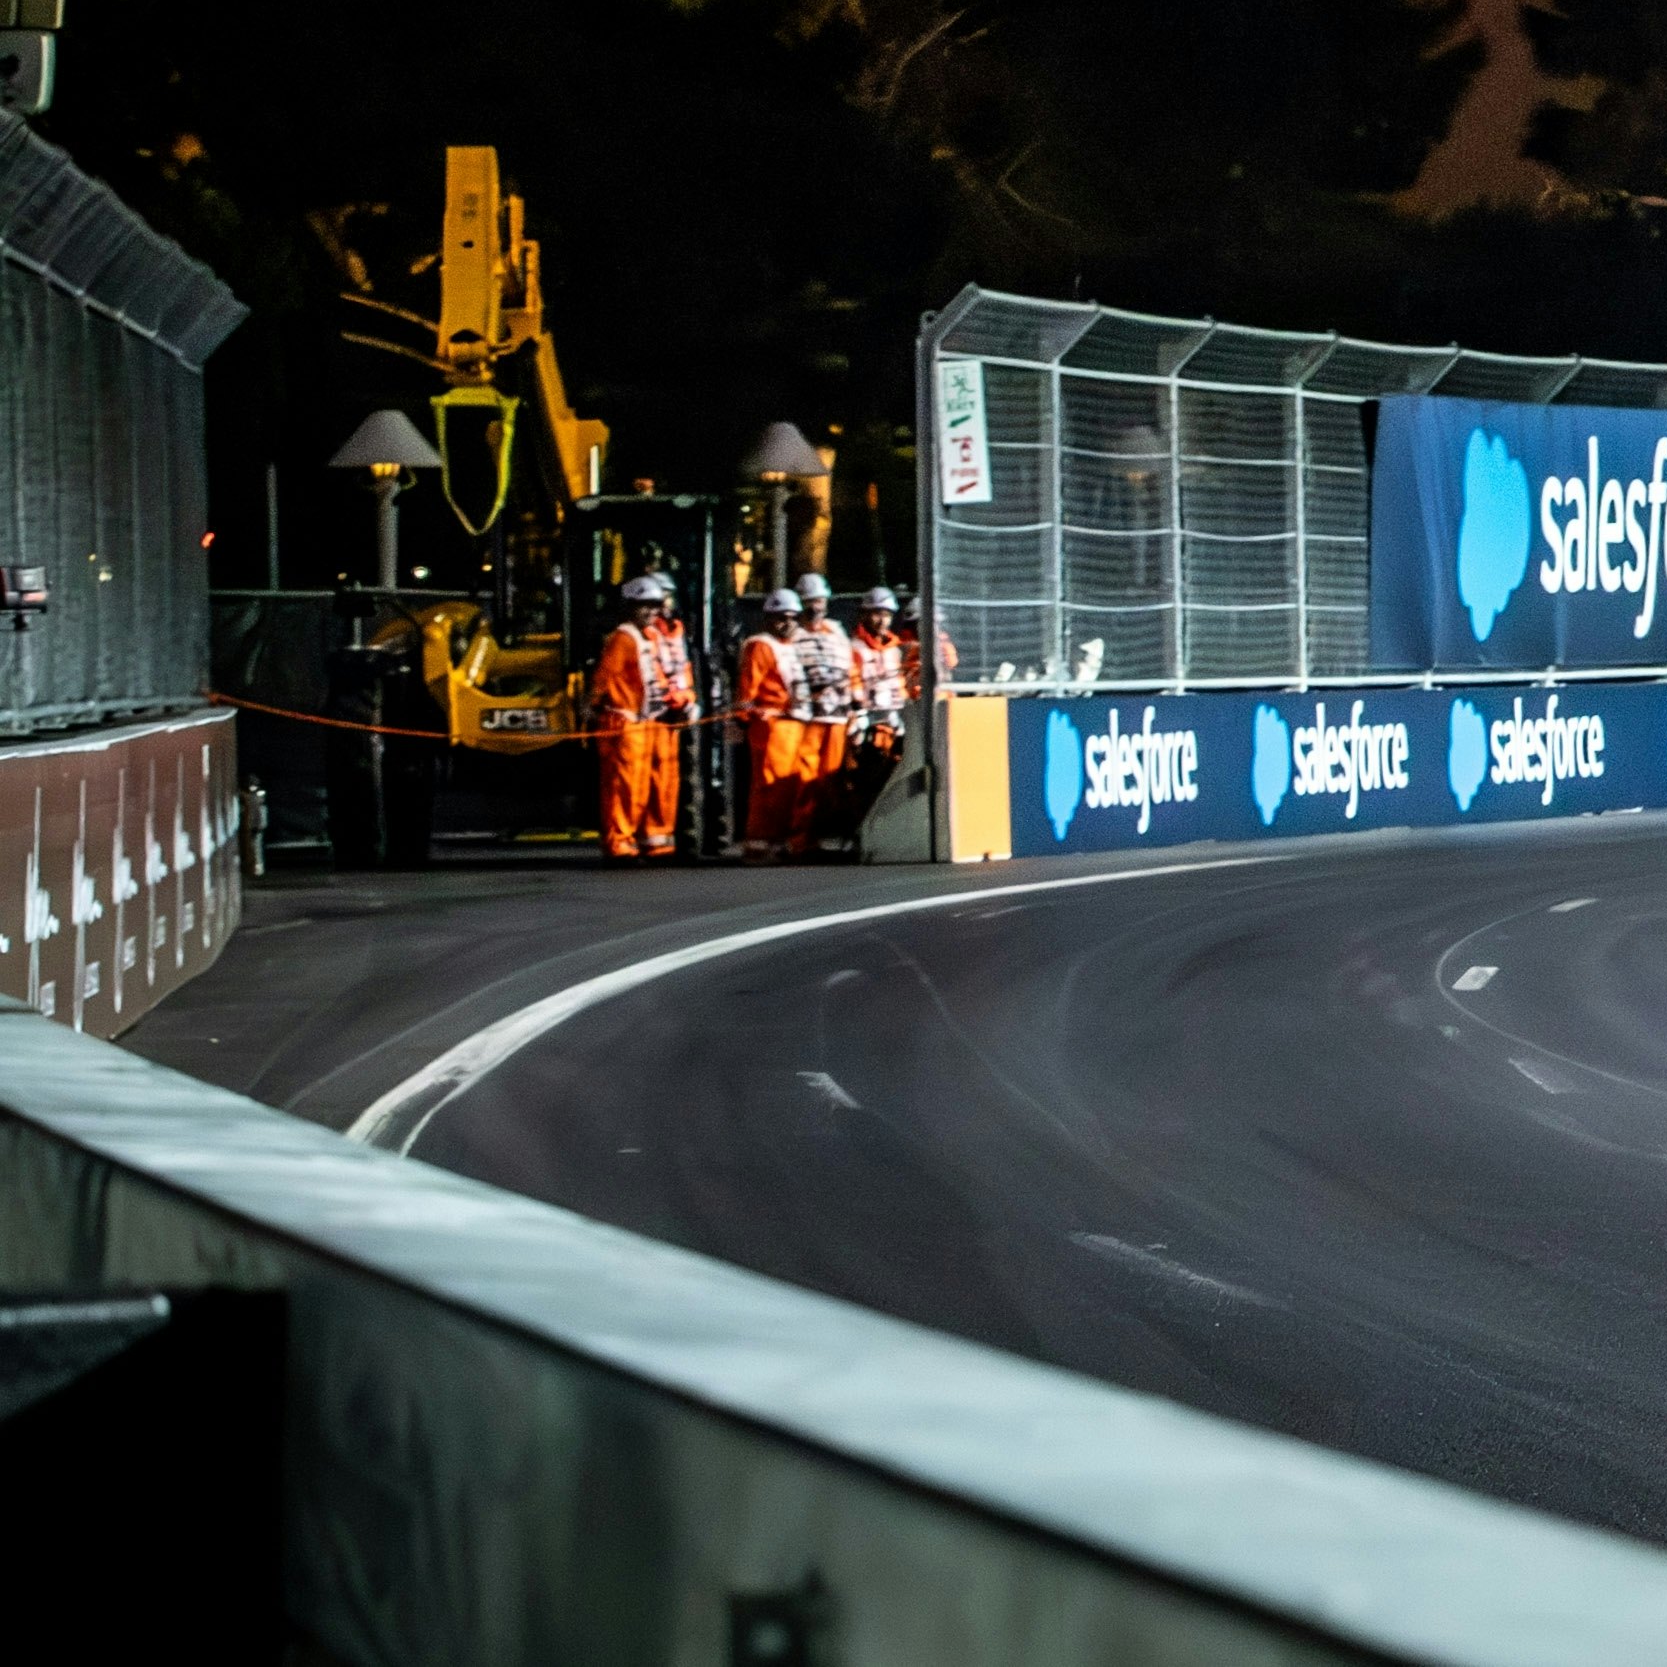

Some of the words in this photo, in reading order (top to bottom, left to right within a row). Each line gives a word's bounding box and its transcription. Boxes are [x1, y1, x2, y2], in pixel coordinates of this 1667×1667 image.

[1085, 705, 1199, 834] salesforce
[1293, 700, 1409, 819] salesforce
[1490, 695, 1605, 806] salesforce
